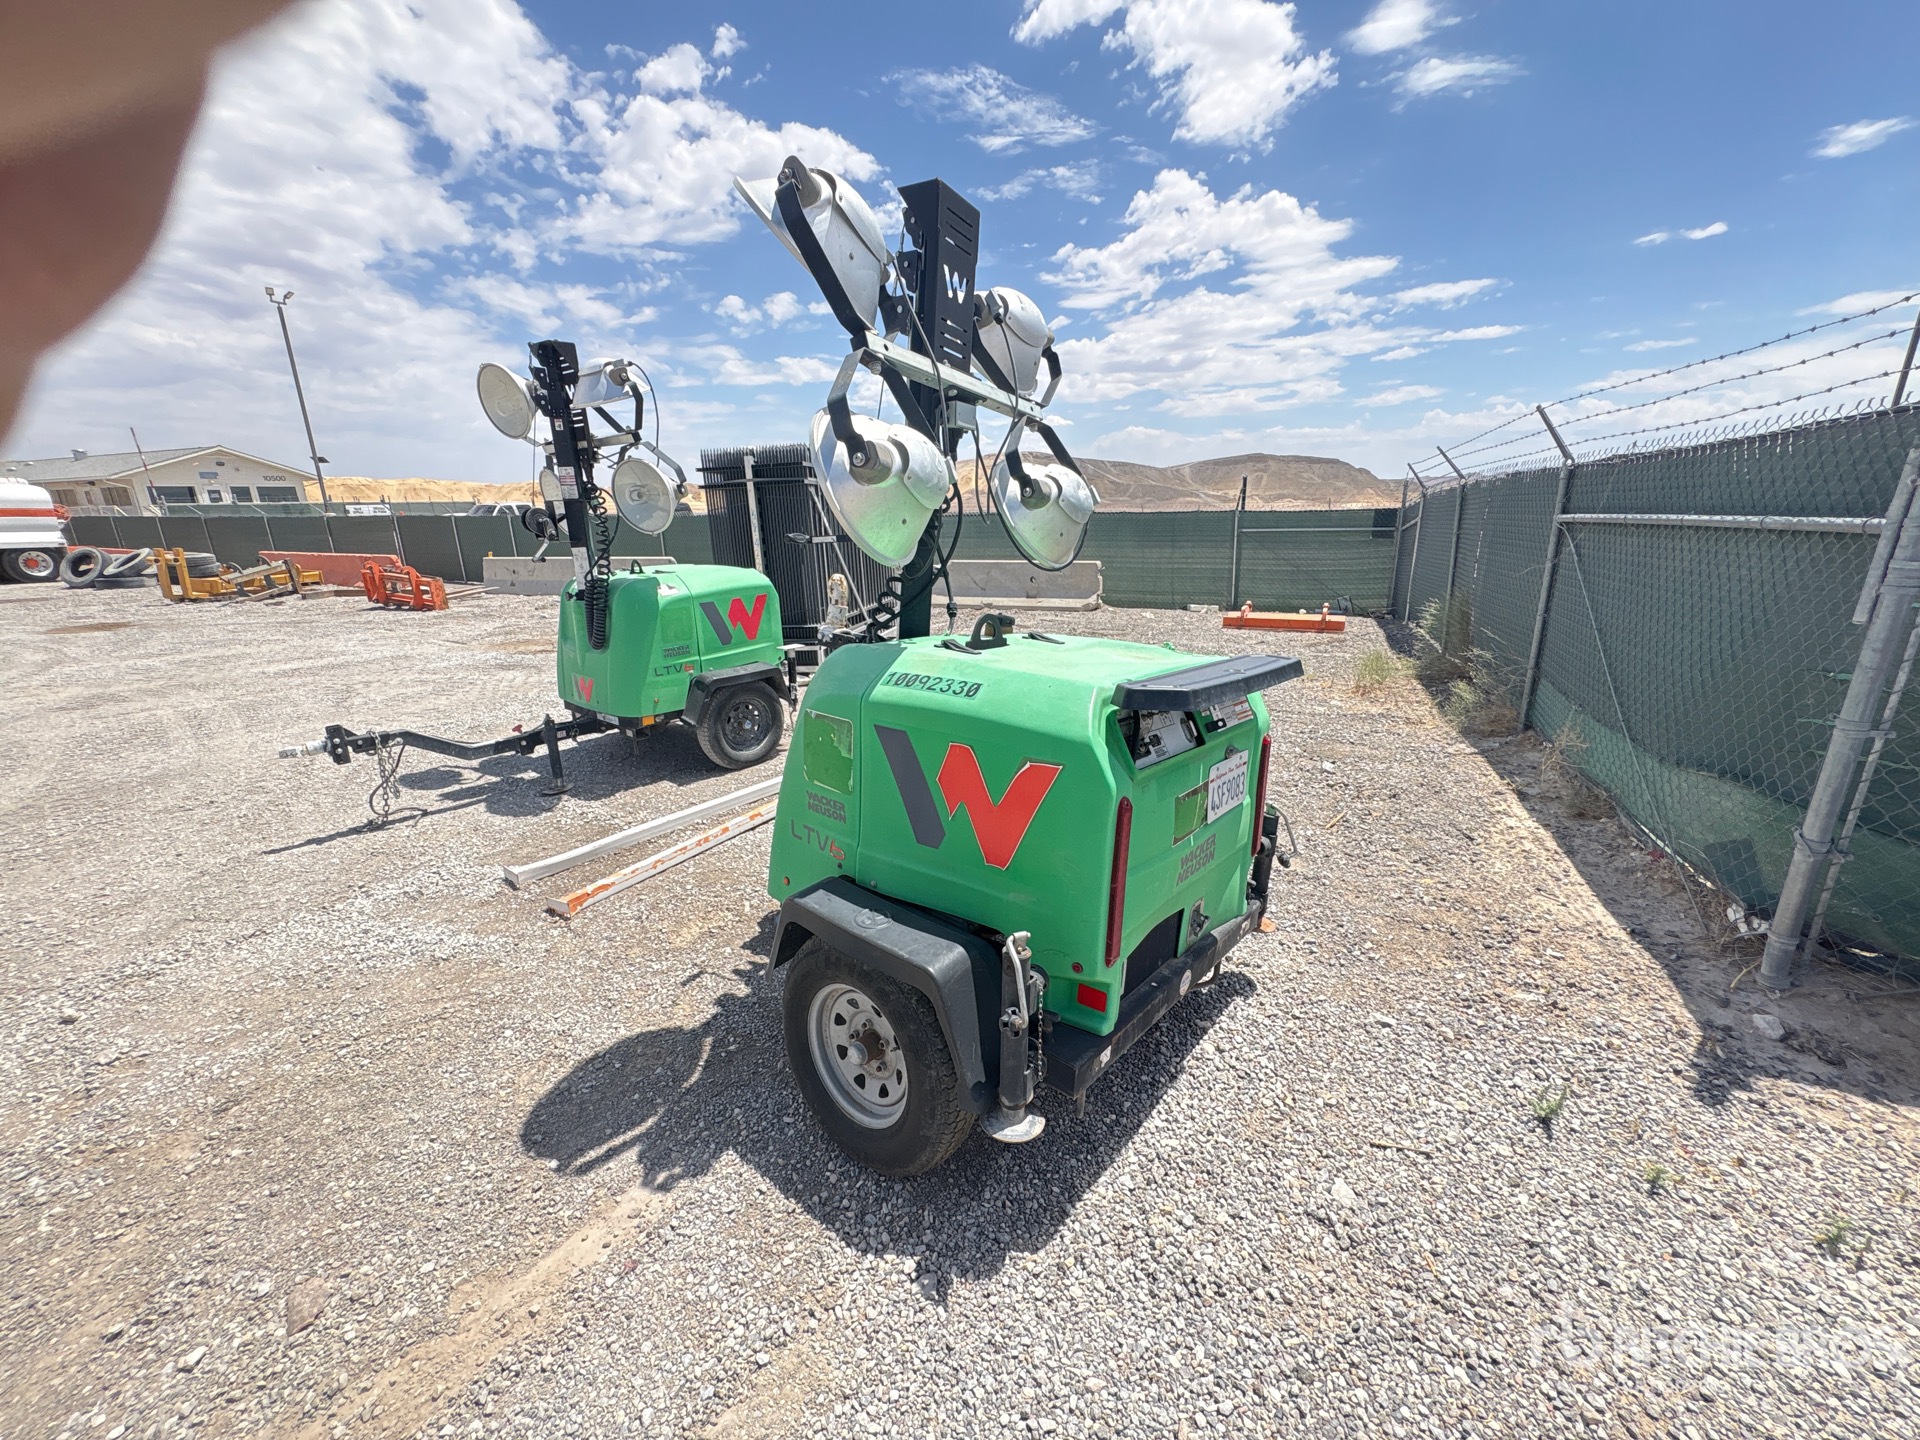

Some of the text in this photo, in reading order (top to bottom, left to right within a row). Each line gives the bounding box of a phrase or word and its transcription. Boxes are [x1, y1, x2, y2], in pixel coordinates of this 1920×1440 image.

[886, 671, 983, 698] 10092330
[806, 789, 847, 814] WACKER
[1211, 771, 1246, 813] 4SF9083
[808, 800, 847, 825] NEUSON
[1180, 832, 1217, 870] WACKER
[1176, 848, 1216, 887] NEUSON
